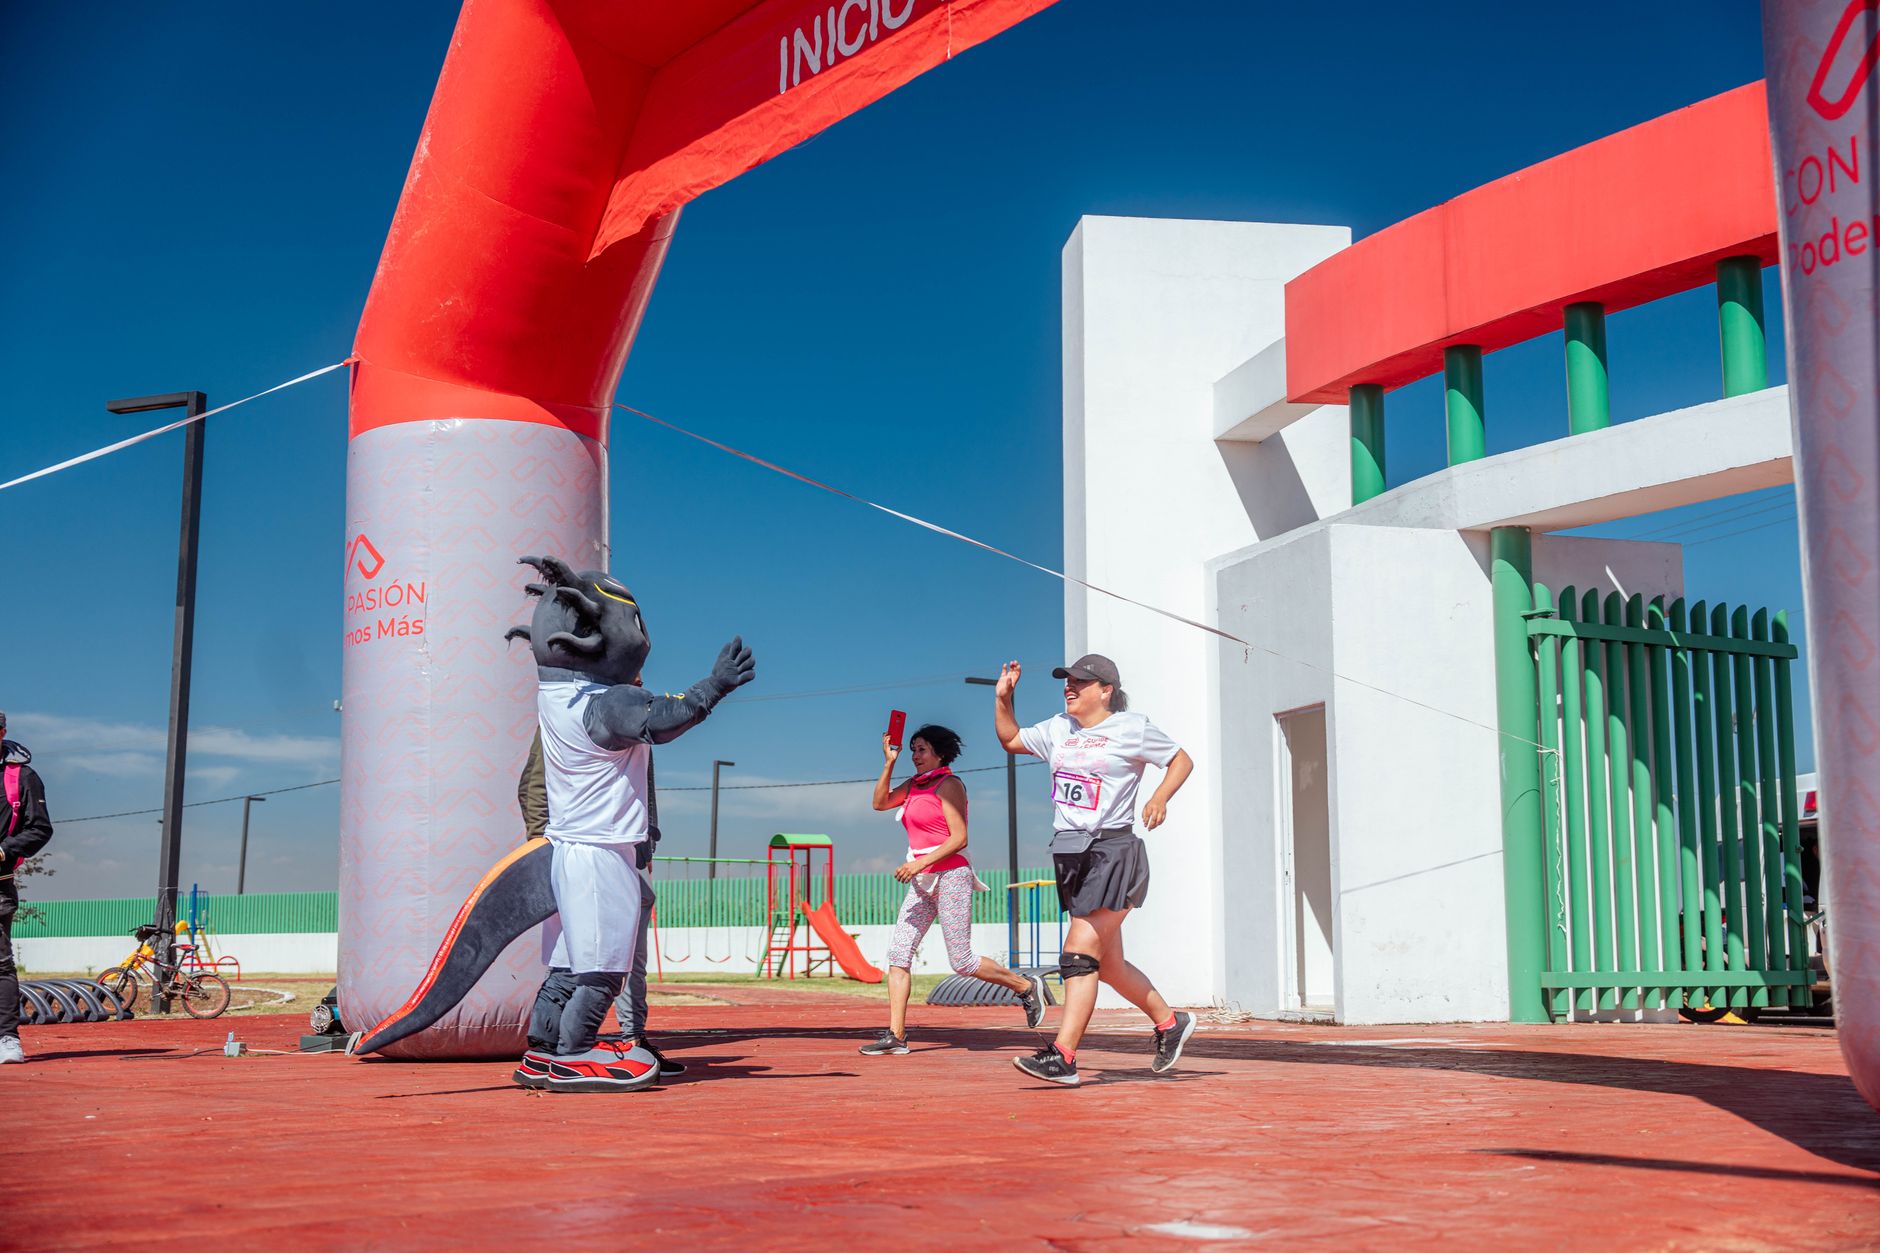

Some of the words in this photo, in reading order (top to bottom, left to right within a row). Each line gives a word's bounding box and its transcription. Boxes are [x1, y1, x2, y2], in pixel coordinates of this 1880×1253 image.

[347, 579, 425, 614] PASIÓN
[377, 614, 424, 639] Más
[1063, 783, 1082, 801] 16
